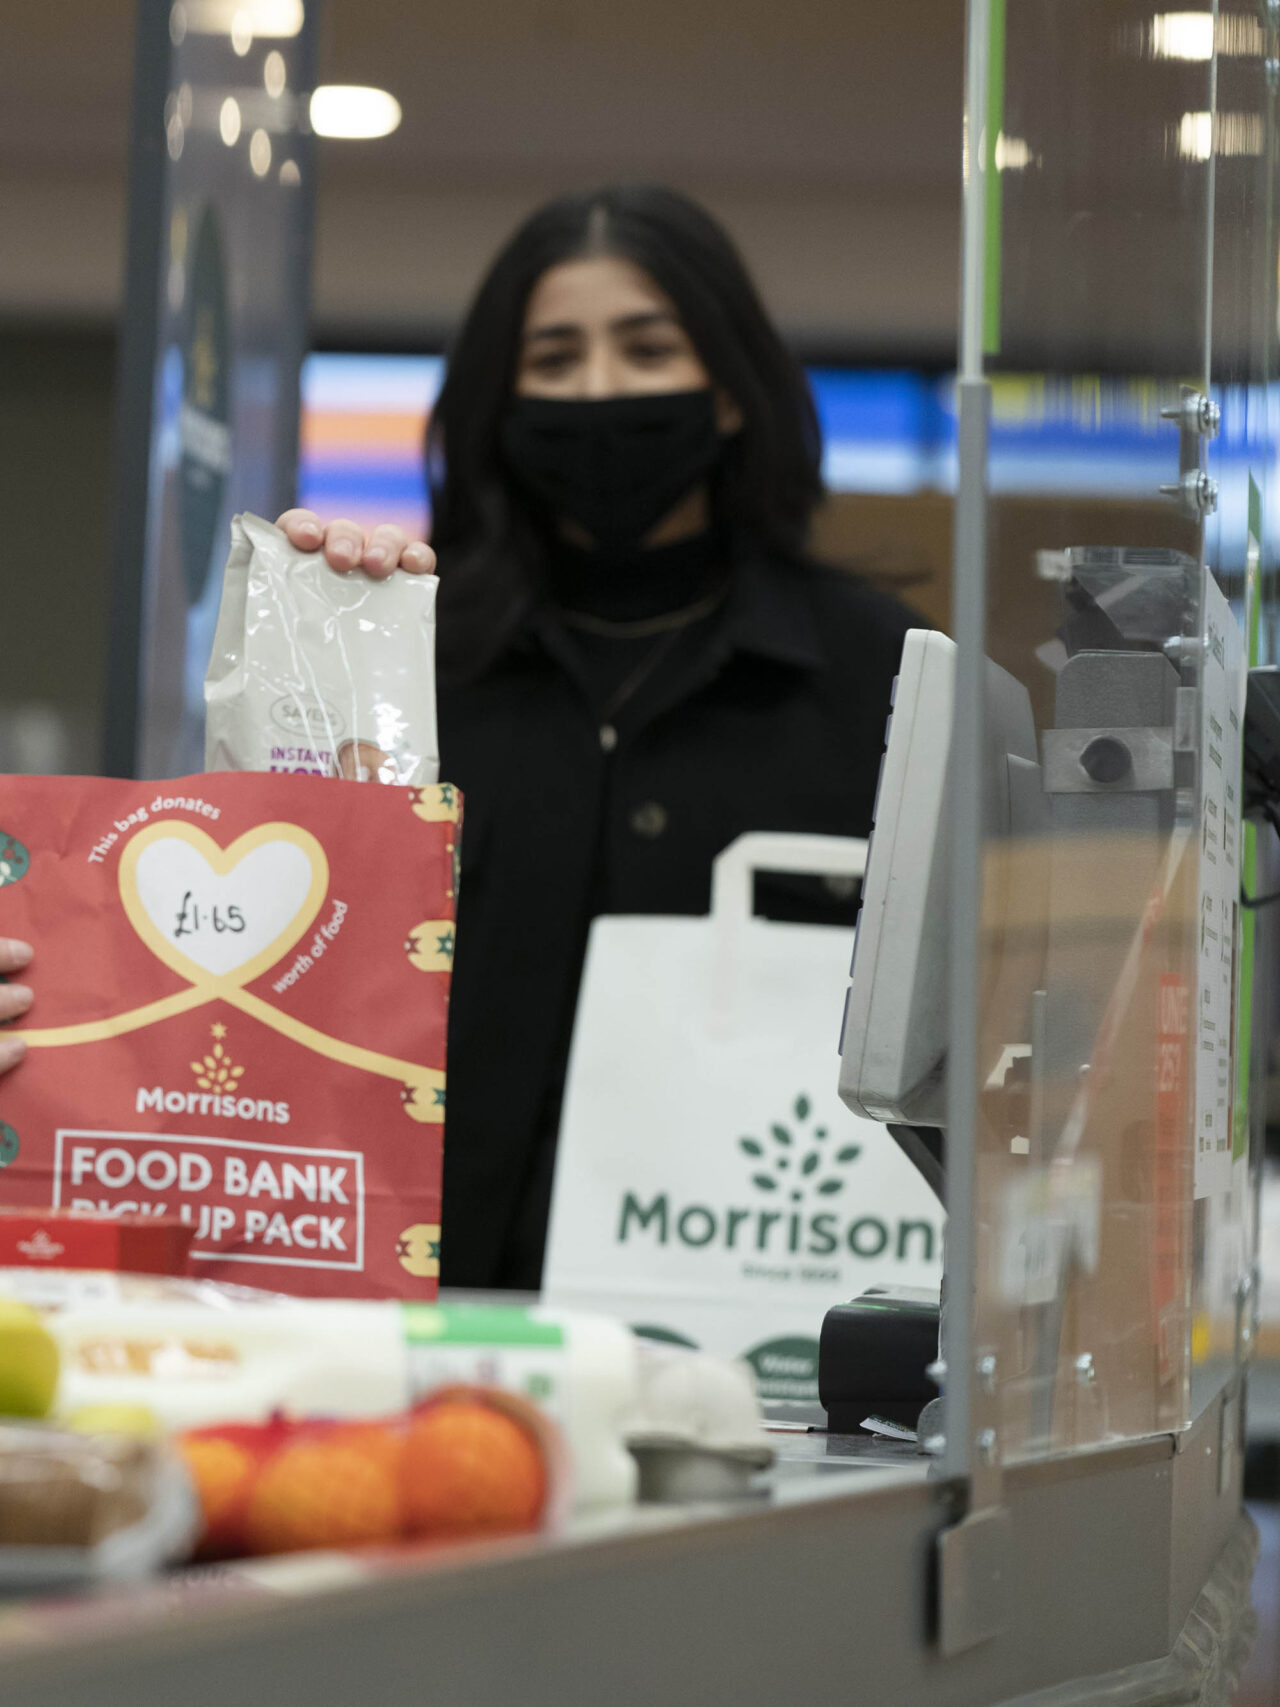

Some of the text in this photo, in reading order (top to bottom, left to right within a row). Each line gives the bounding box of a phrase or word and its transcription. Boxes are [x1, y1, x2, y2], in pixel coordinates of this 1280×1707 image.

[271, 747, 331, 764] INSTANT
[88, 796, 221, 864] This bag donates
[272, 899, 348, 994] worth of food
[135, 1086, 291, 1124] Morrisons
[71, 1147, 350, 1205] FOOD BANK
[244, 1210, 347, 1250] PACK
[616, 1191, 936, 1263] Morrison
